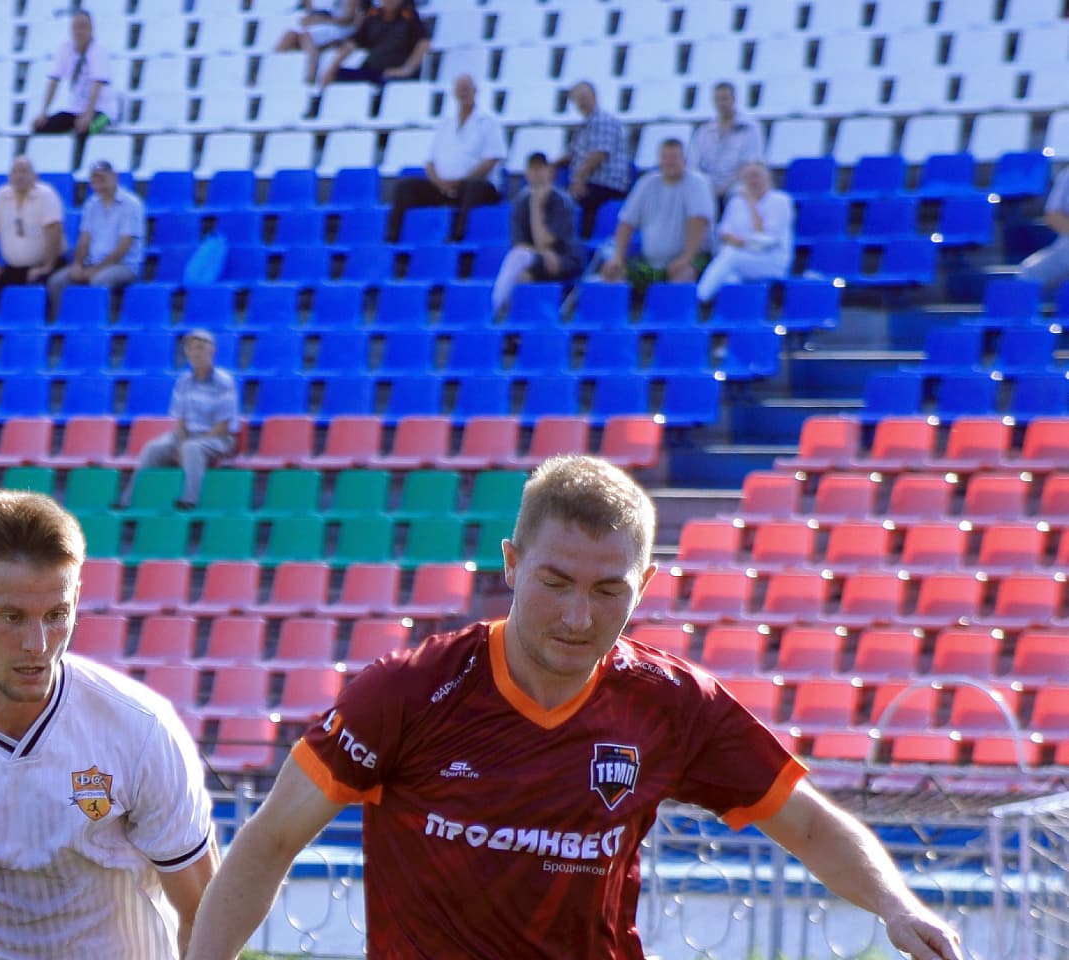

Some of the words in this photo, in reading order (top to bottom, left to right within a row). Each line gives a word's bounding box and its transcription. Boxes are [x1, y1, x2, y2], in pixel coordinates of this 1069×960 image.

[338, 728, 378, 769] ПСБ
[439, 769, 480, 779] SportLife
[596, 762, 636, 786] ТЕМП
[425, 812, 626, 860] ПРОДИНВЕСТ
[542, 860, 606, 876] Бродников
